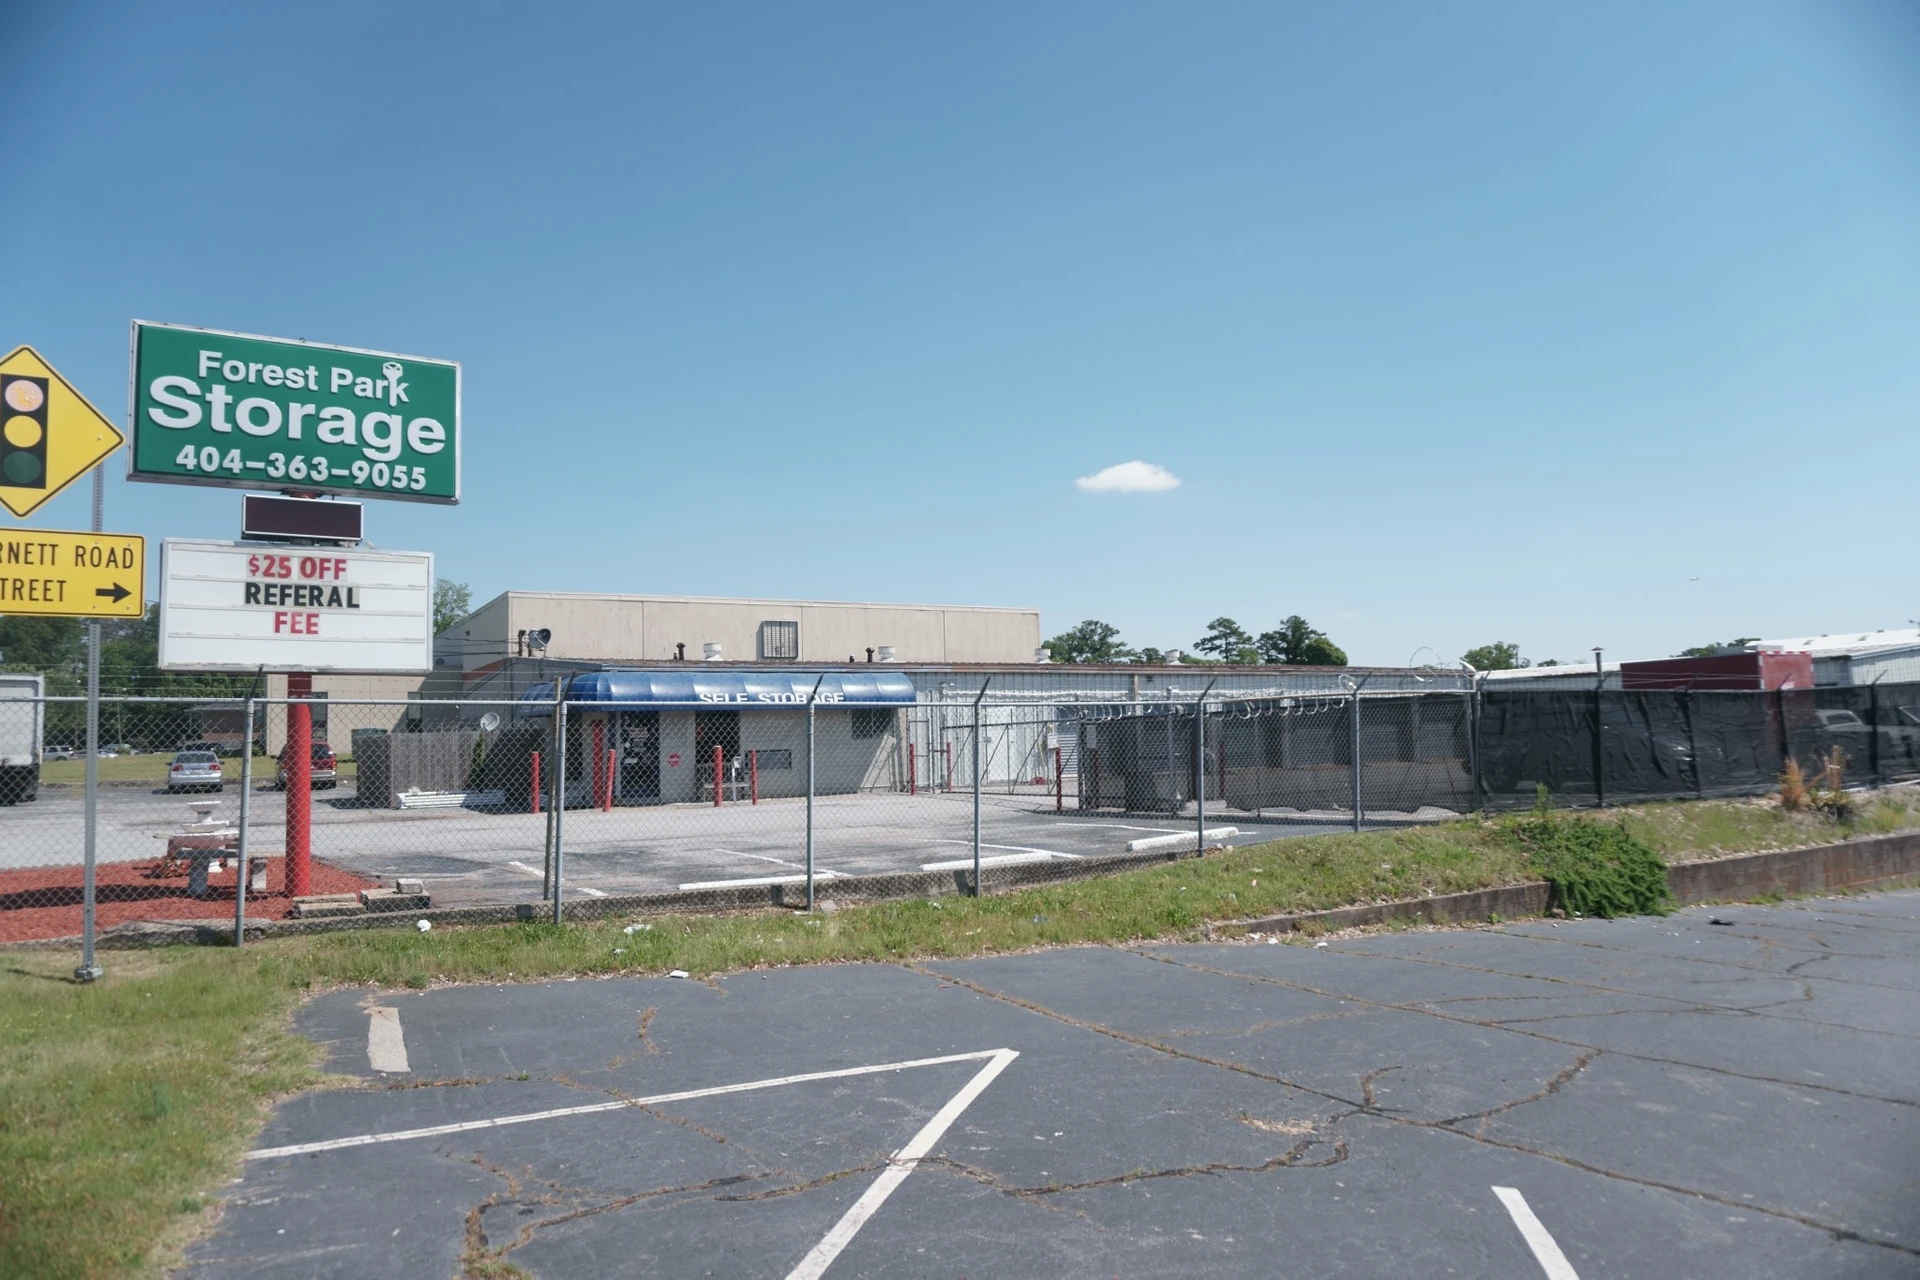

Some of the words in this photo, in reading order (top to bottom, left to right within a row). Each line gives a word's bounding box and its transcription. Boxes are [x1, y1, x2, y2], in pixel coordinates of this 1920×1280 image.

[199, 350, 319, 391] Forest
[330, 362, 410, 407] Park
[148, 375, 446, 462] Storage
[175, 445, 426, 491] 404-363-9055
[75, 545, 134, 569] ROAD
[248, 554, 292, 579] $25
[300, 556, 347, 580] OFF
[245, 582, 360, 609] REFERAL
[274, 611, 320, 635] FEE
